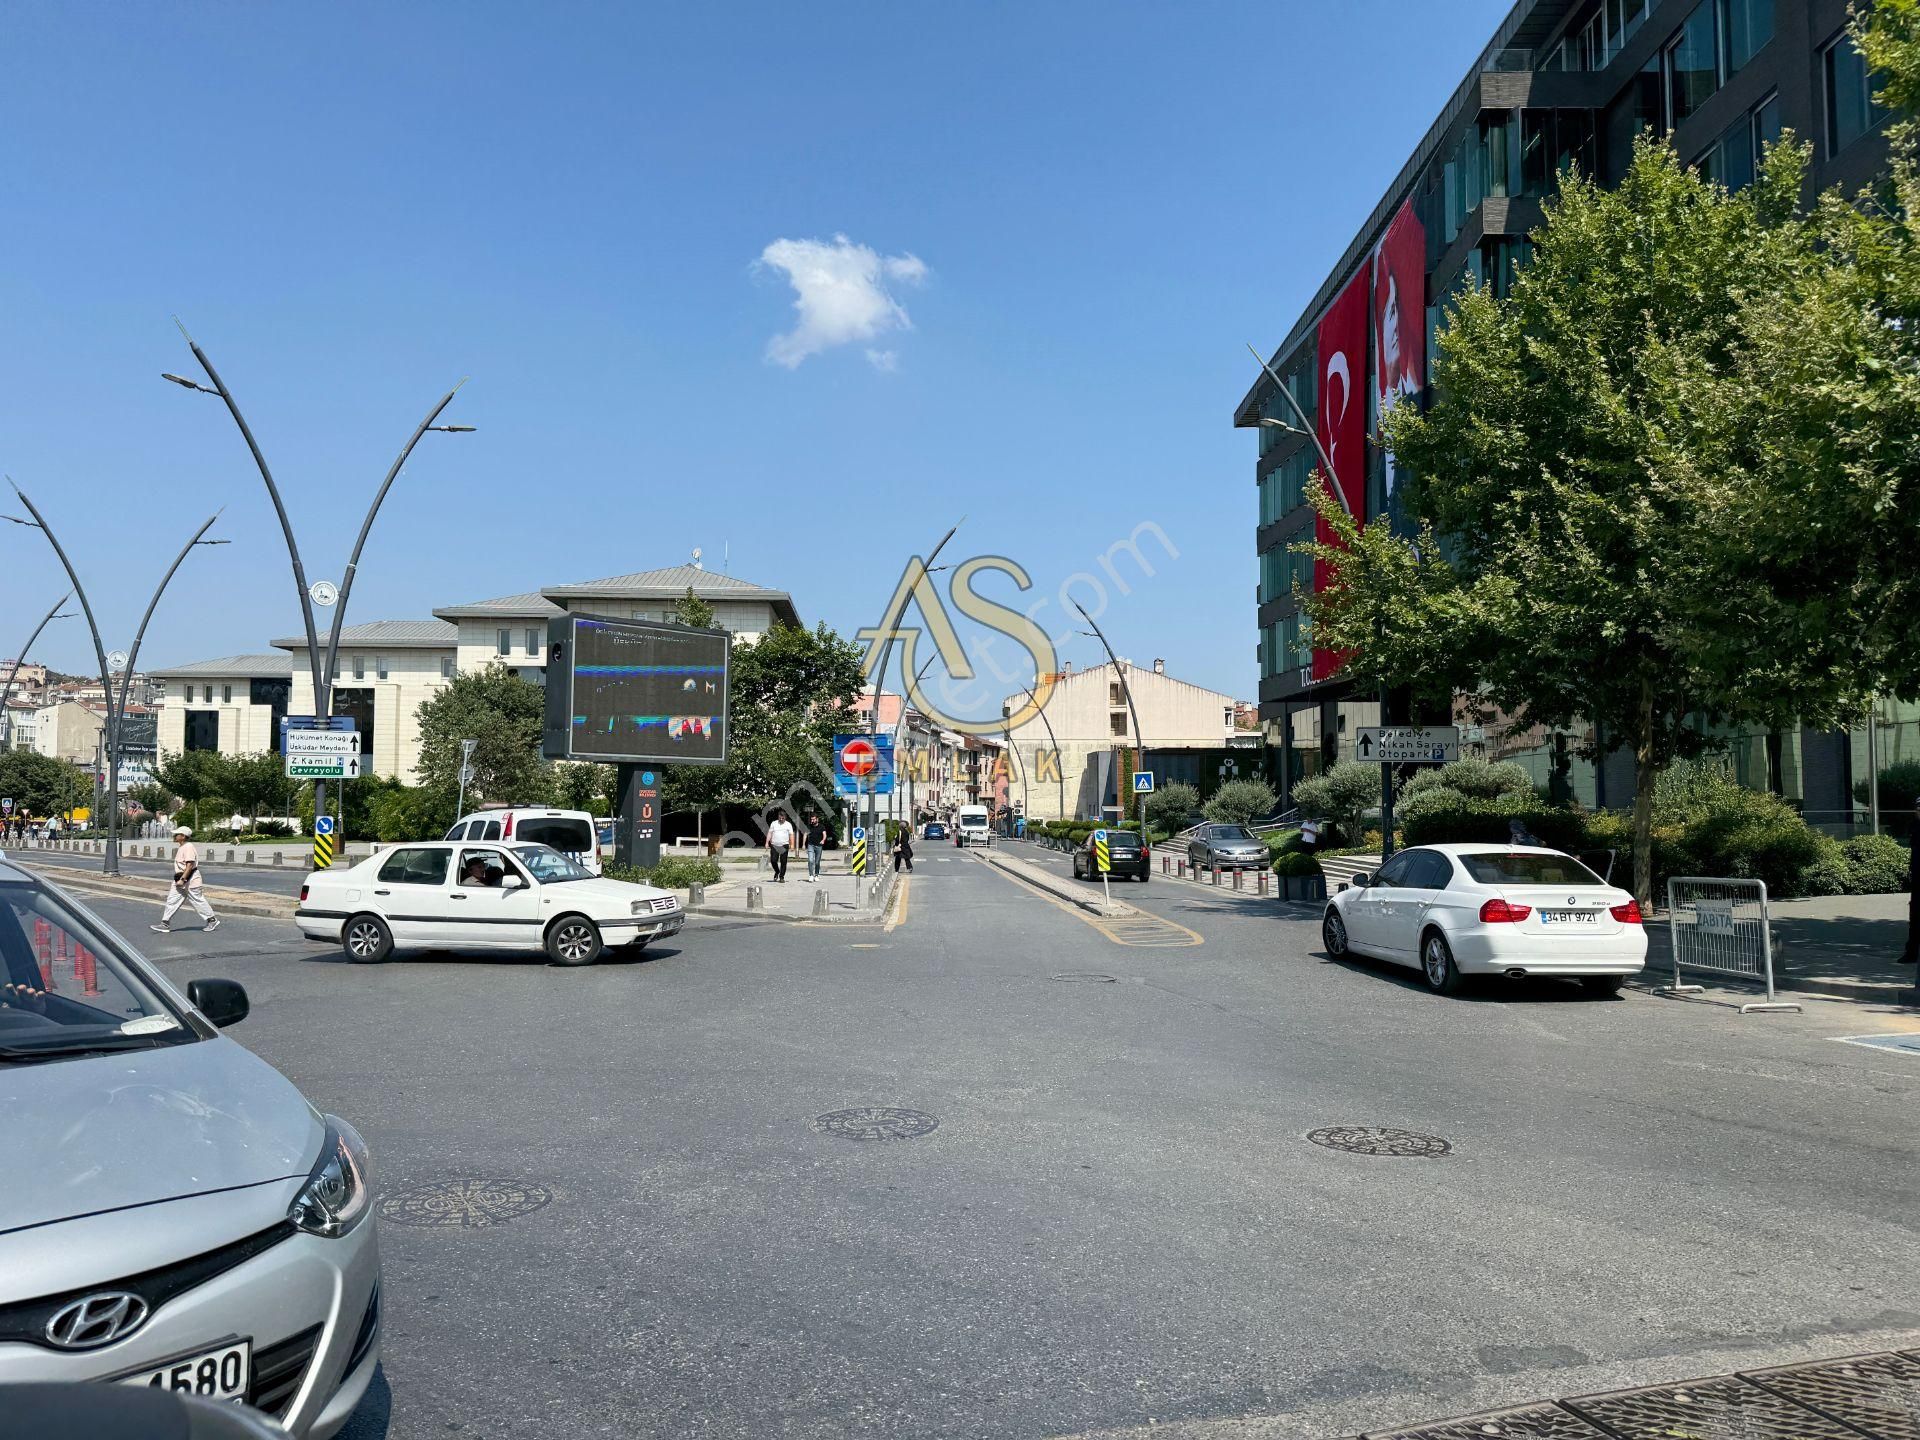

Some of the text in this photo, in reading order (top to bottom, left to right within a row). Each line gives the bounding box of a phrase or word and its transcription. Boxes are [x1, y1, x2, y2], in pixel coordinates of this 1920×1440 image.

[1379, 730, 1431, 739] Belediye
[1380, 741, 1455, 750] Nikah Sarayı
[1379, 749, 1430, 760] Otopark
[290, 766, 341, 774] Çevreyolu
[1546, 912, 1597, 922] 34 BT 9721
